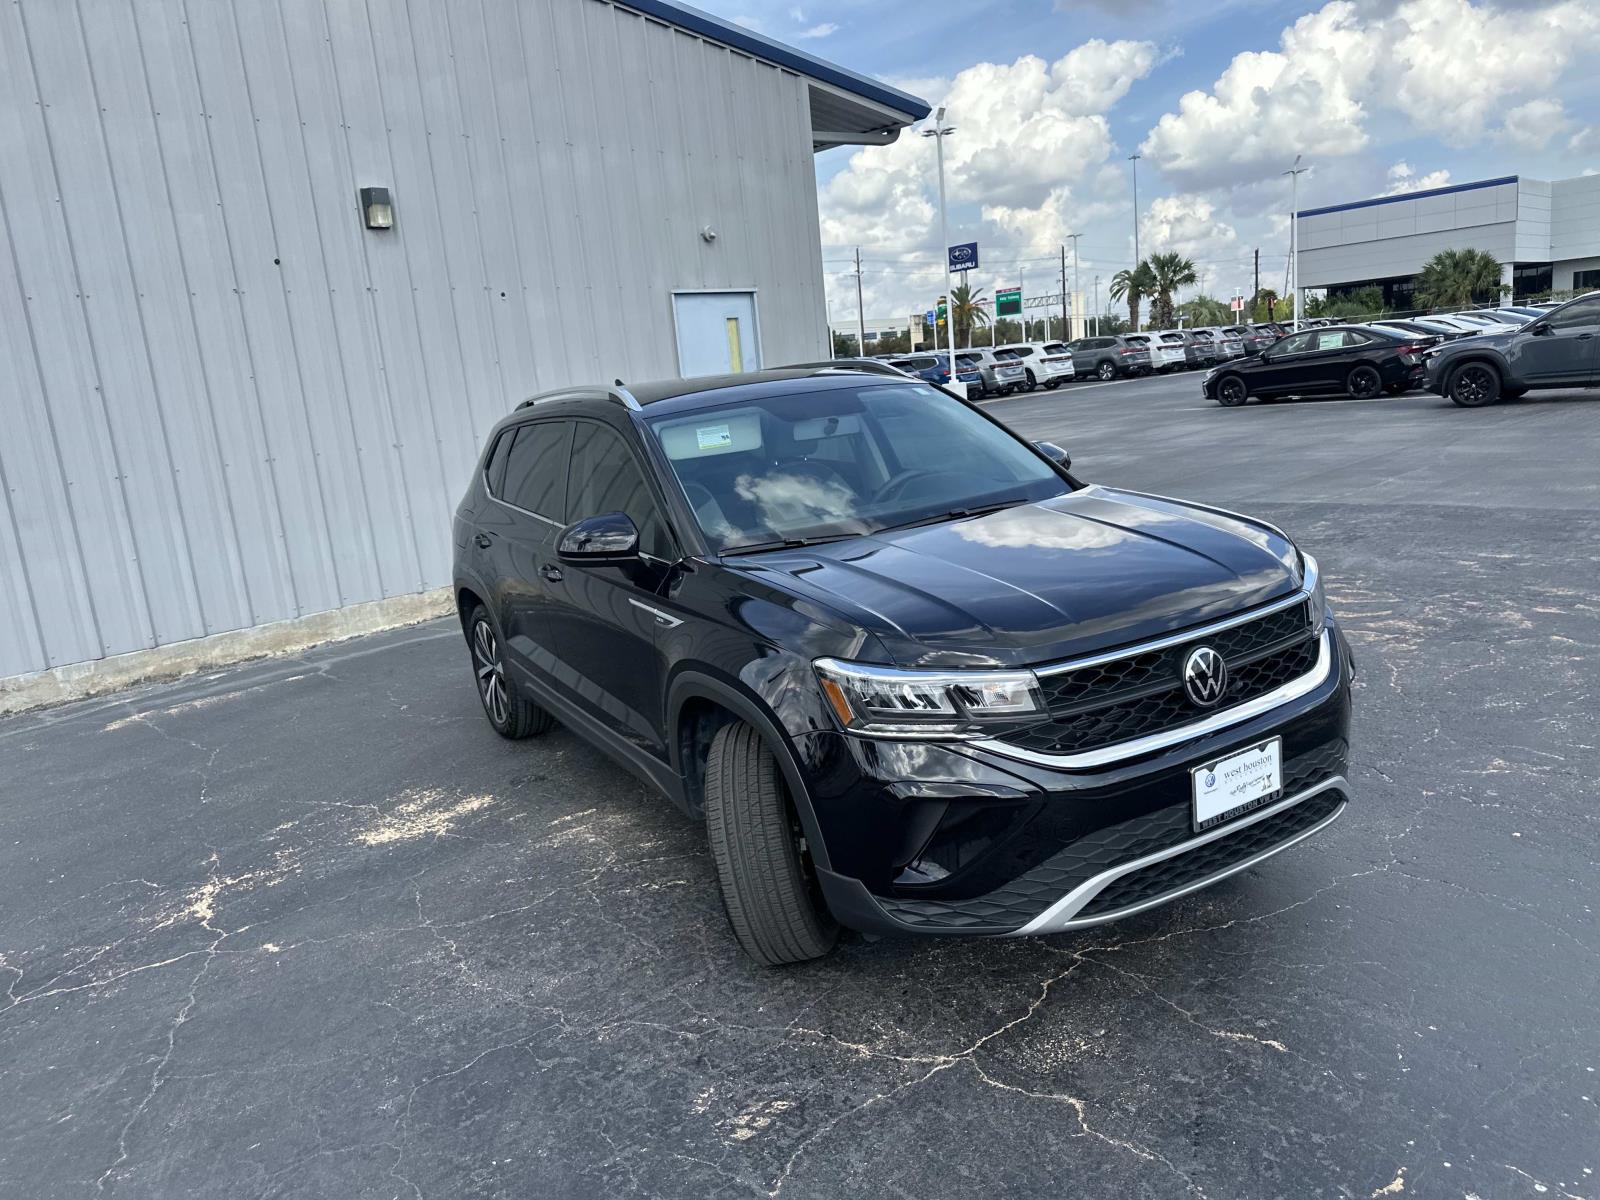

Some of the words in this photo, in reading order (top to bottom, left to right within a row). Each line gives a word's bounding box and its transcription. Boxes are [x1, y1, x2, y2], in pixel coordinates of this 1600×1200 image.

[949, 261, 975, 271] SUBARU
[1224, 768, 1241, 780] west
[1243, 754, 1272, 772] houston
[1202, 817, 1221, 828] WEST
[1223, 801, 1258, 820] HOUSTON
